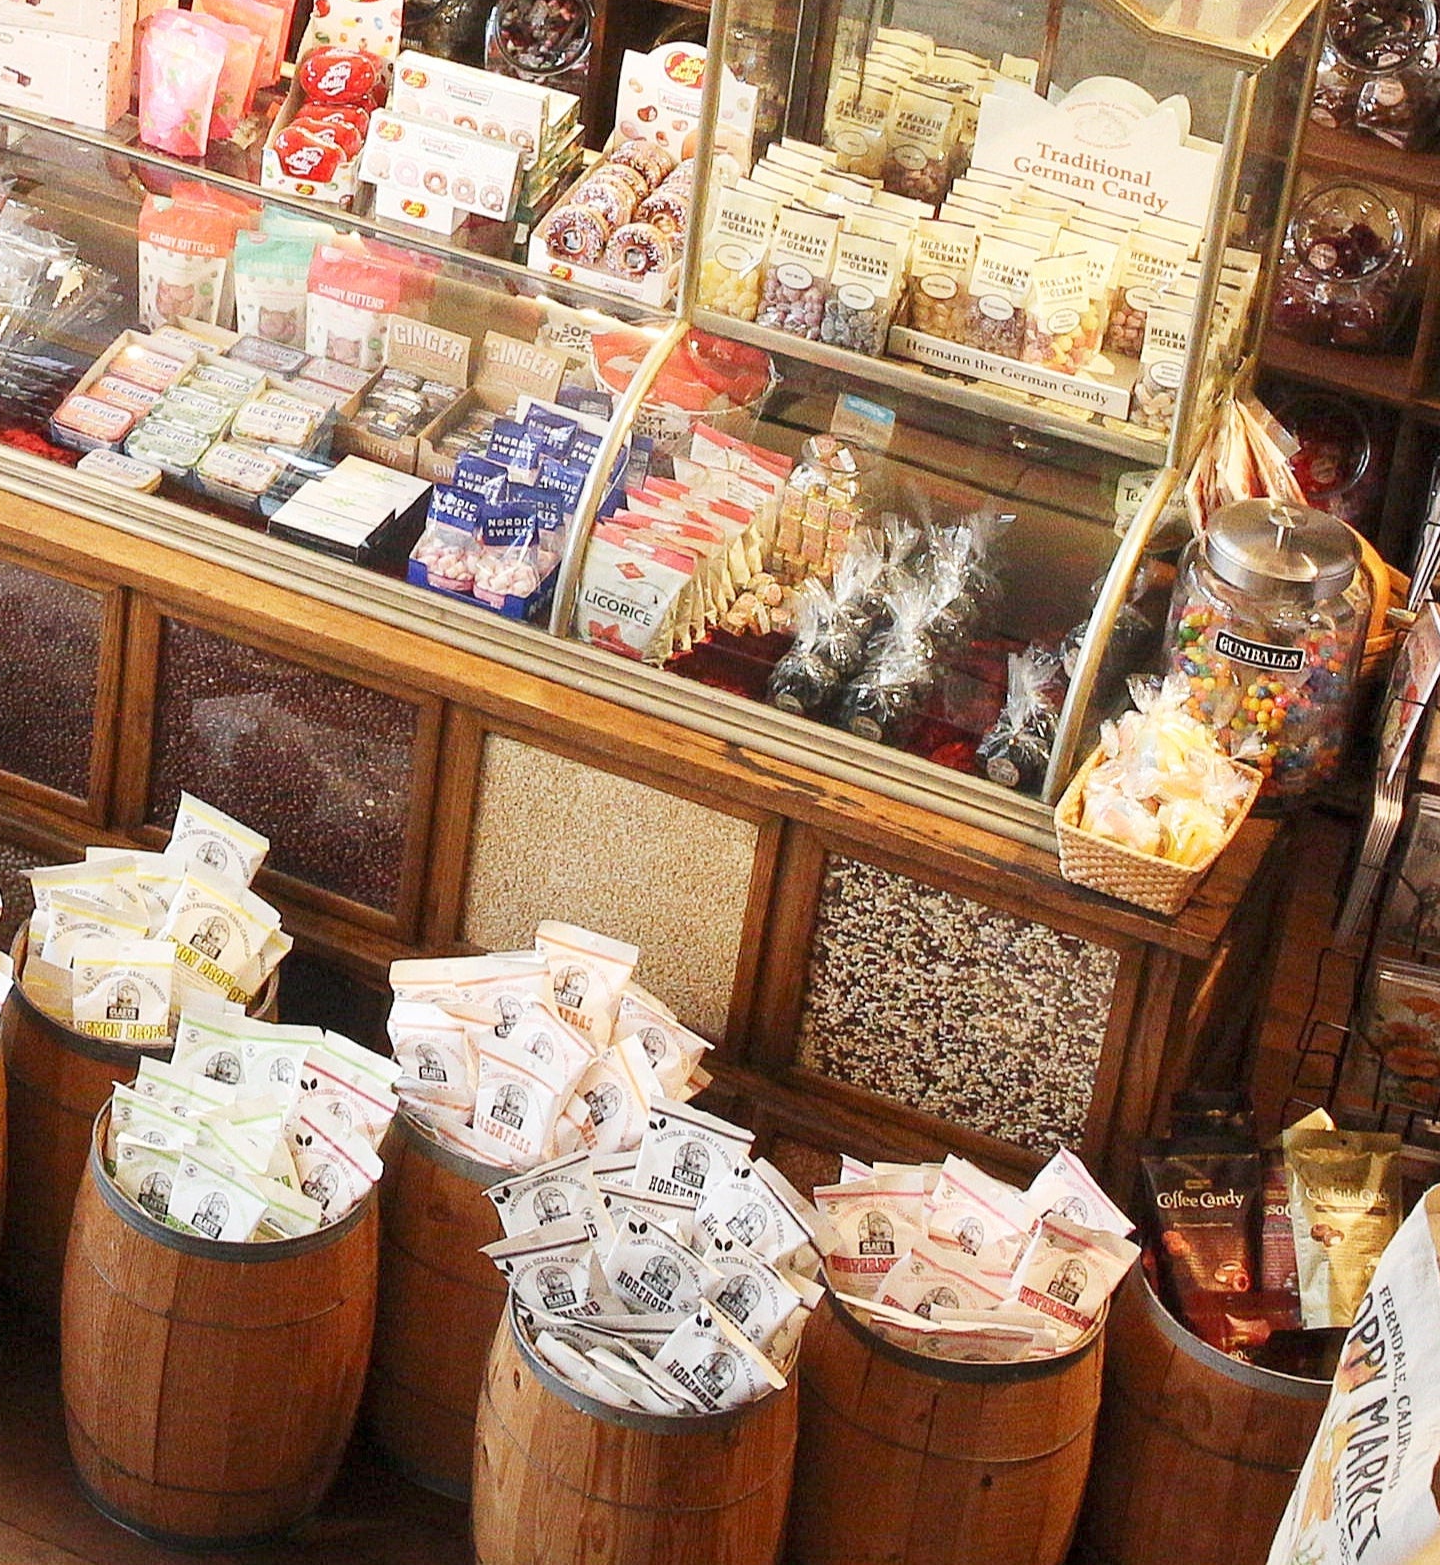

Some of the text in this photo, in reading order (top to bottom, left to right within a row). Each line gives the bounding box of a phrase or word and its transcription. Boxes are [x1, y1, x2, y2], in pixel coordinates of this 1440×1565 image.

[1035, 141, 1153, 188] Traditional
[1014, 155, 1169, 213] German Candy
[721, 208, 767, 232] HERMANN
[728, 219, 766, 240] GERMAN
[149, 231, 216, 254] CANDY KITTENS
[779, 228, 829, 250] HERMANN
[787, 240, 827, 261] GERMAN
[921, 238, 970, 258] HERMANN
[841, 249, 889, 270] HERMANN
[850, 259, 888, 277] GERMAN
[929, 248, 969, 265] GERMAN
[318, 282, 386, 310] CANDY KITTENS
[394, 321, 464, 364] GINGER
[1150, 324, 1187, 342] HERMA
[486, 340, 559, 381] GINGER
[906, 339, 1110, 407] Hermann the German Candy
[270, 410, 307, 425] CHIPS
[584, 588, 653, 628] LICORICE
[1219, 636, 1299, 668] GUMBALLS
[125, 1021, 176, 1041] DROPS
[1156, 1188, 1245, 1211] Coffee Candy
[1378, 1284, 1407, 1392] FERNDALE,
[1347, 1396, 1386, 1561] MARKET
